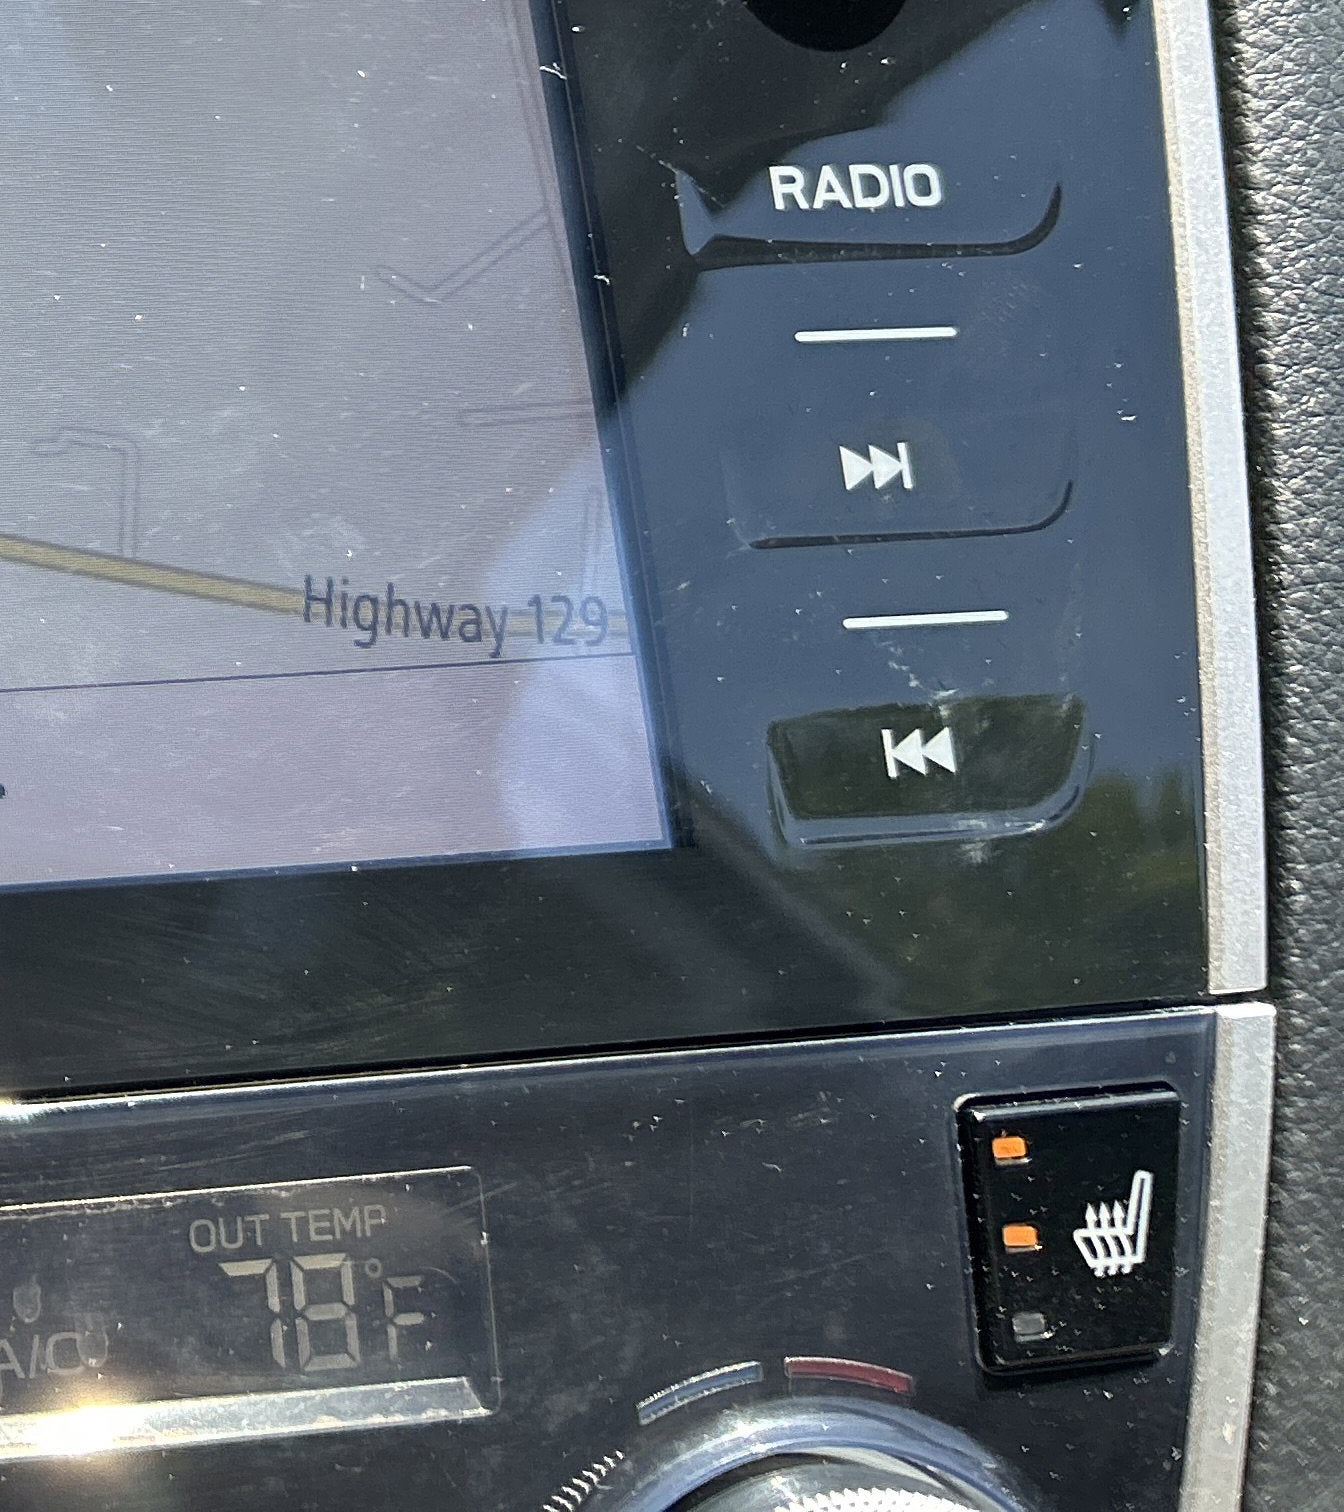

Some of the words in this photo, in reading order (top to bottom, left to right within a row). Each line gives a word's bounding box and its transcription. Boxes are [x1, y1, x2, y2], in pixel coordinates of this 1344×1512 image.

[768, 162, 944, 212] RADIO
[301, 574, 509, 658] Highway
[526, 593, 610, 648] 129
[188, 1212, 271, 1255] OUT
[280, 1203, 388, 1243] TEMP
